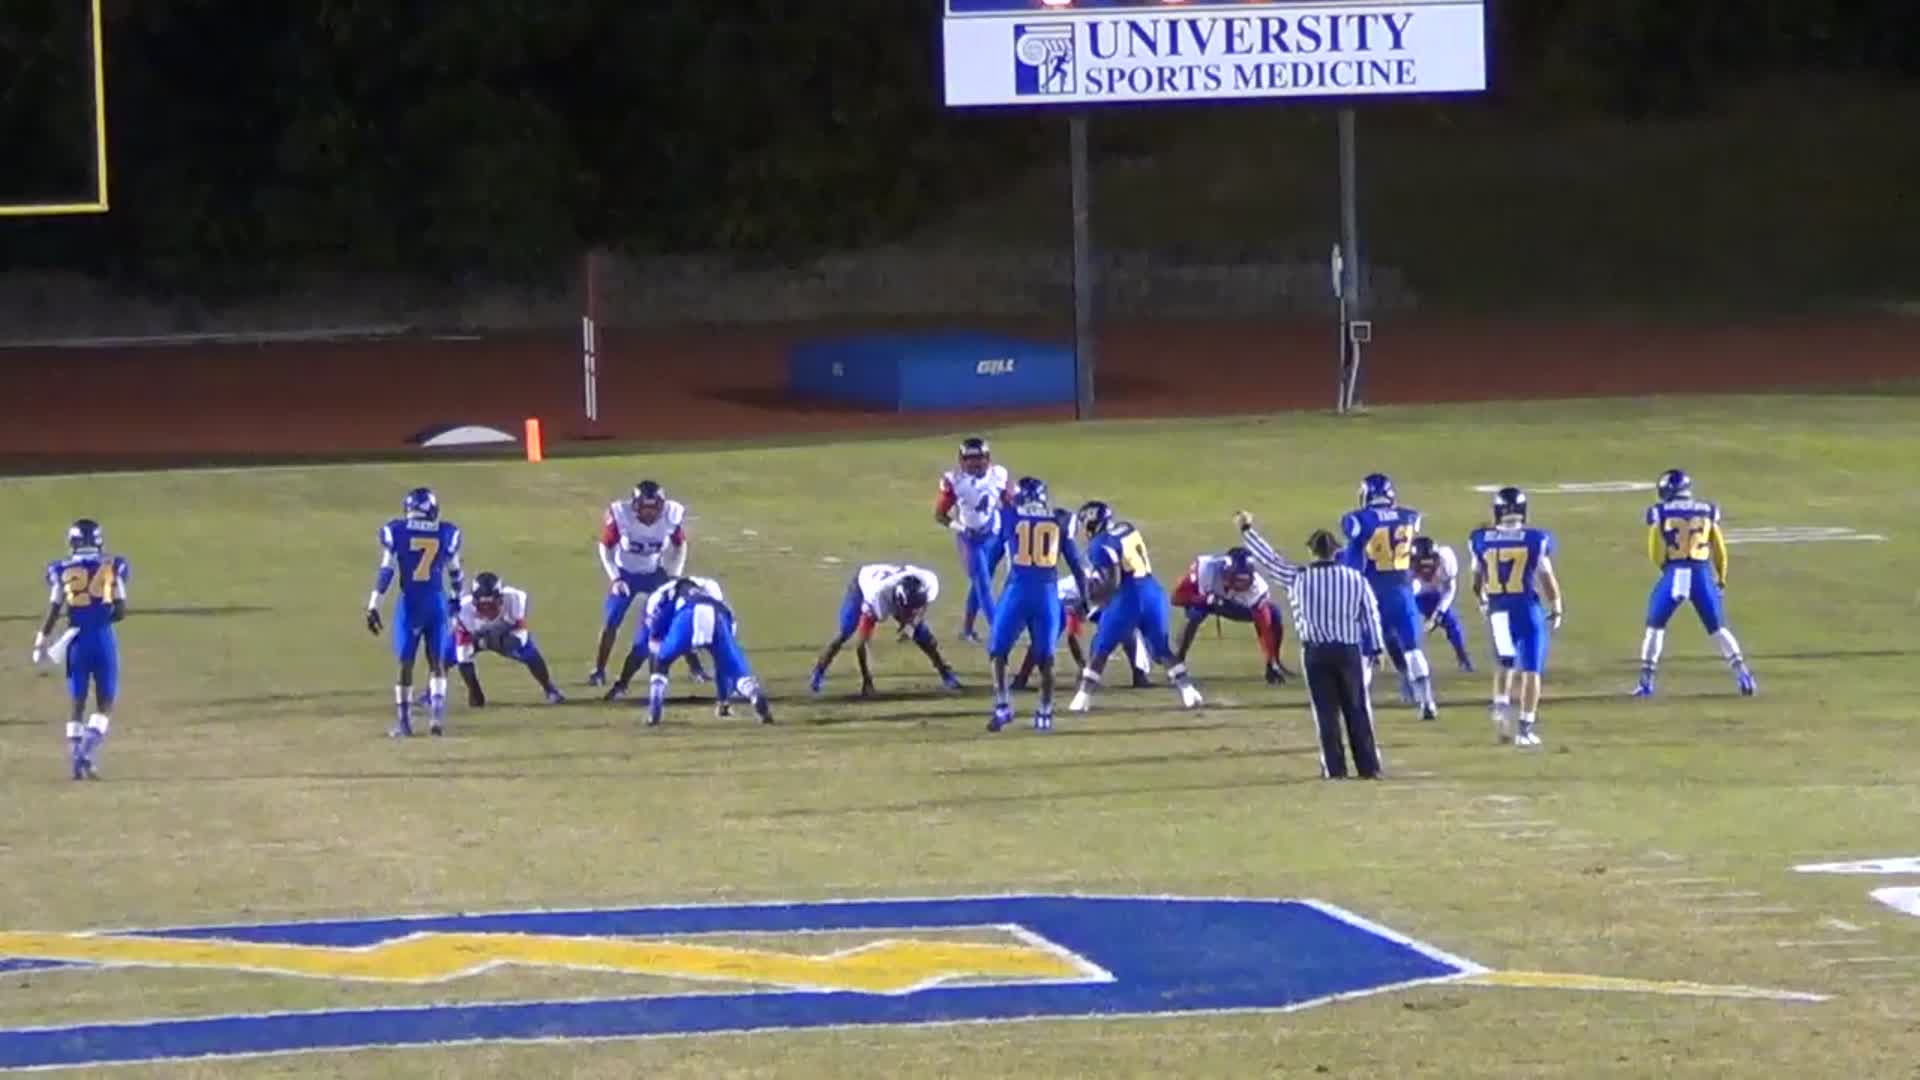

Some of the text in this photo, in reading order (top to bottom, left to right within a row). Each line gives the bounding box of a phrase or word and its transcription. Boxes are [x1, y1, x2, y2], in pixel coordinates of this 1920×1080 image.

[1088, 12, 1414, 59] UNIVERSITY
[1085, 57, 1416, 95] SPORTS MEDICINE
[409, 537, 440, 582] 7
[1014, 520, 1060, 568] 10
[1366, 525, 1413, 571] 42
[1665, 517, 1711, 560] 32
[63, 562, 114, 607] 24
[1483, 547, 1529, 594] 17
